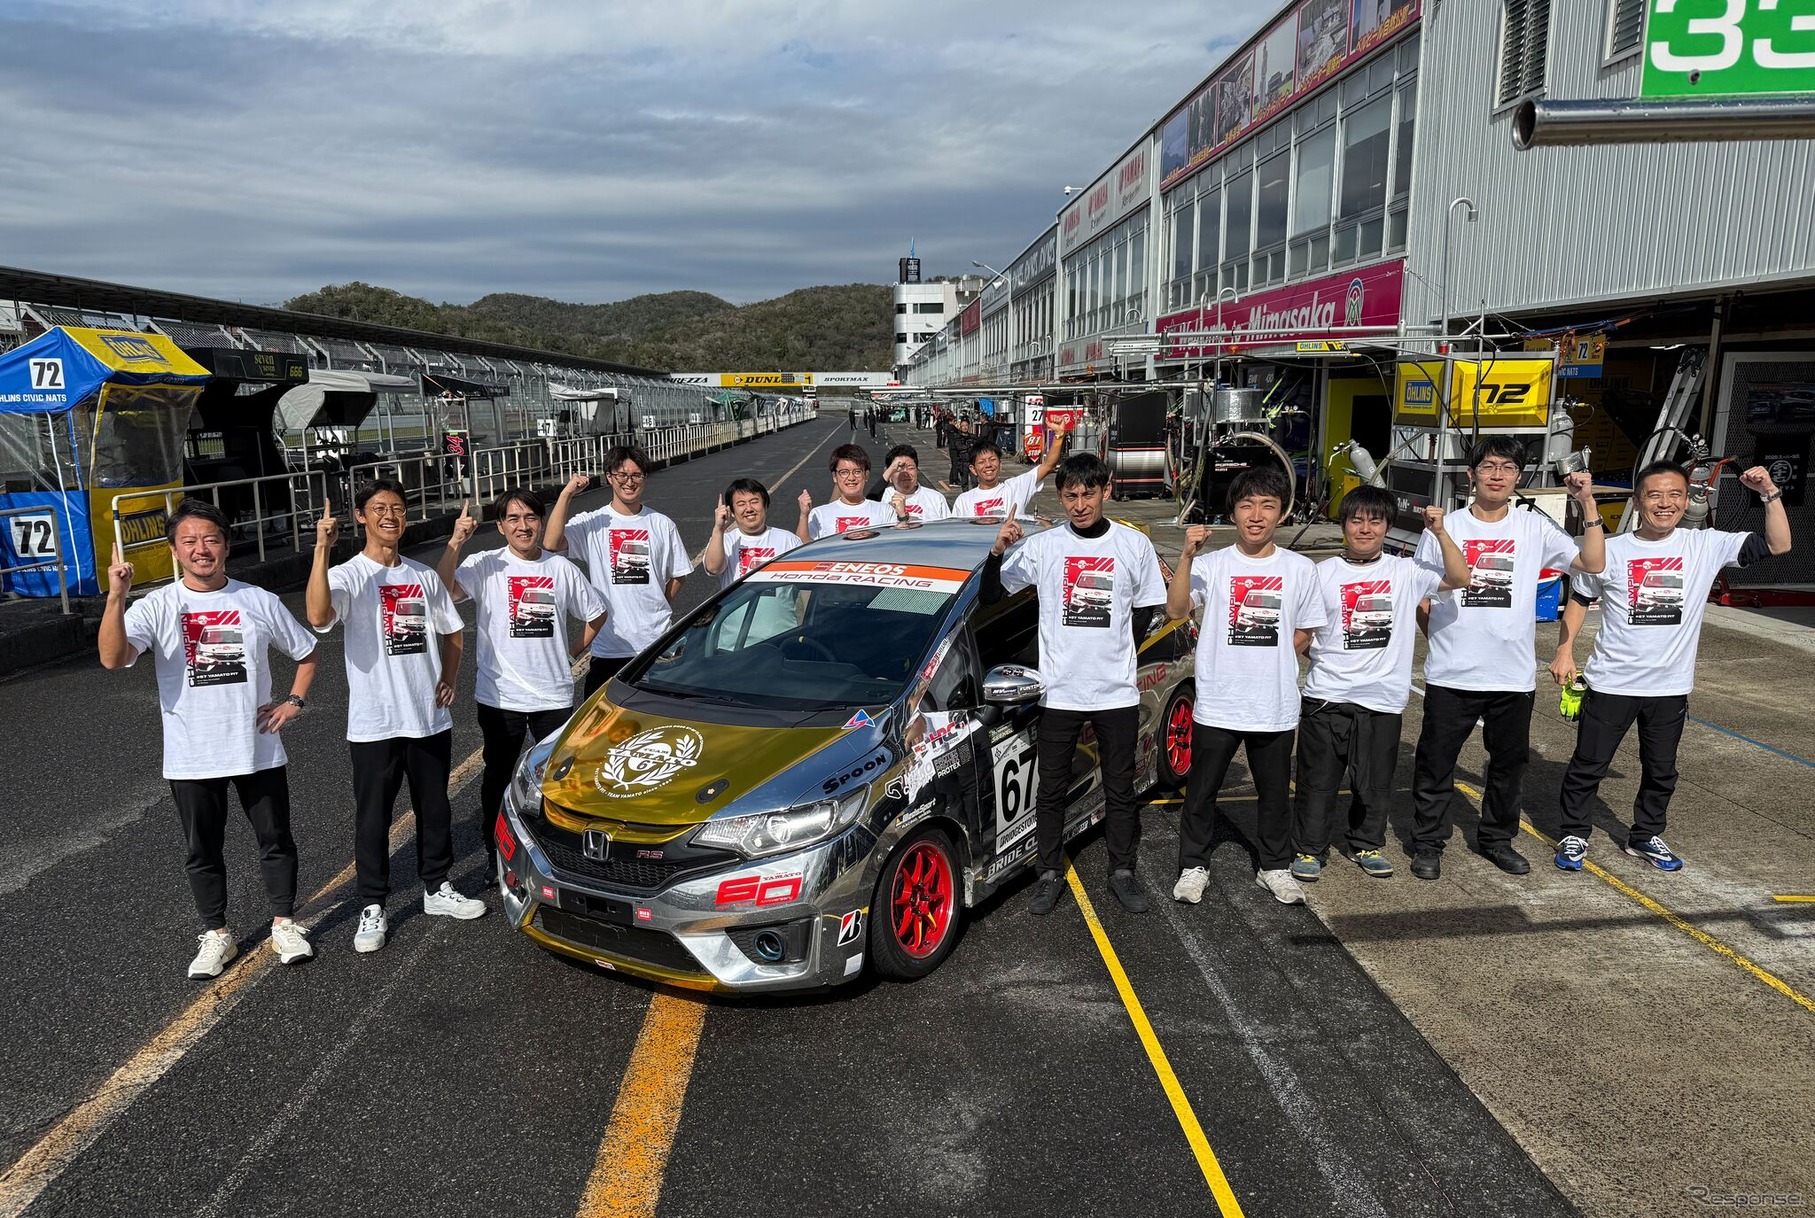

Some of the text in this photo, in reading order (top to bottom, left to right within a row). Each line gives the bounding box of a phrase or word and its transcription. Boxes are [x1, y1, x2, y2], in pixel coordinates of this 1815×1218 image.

[1578, 342, 1589, 360] 72
[32, 361, 62, 387] 72
[22, 393, 44, 402] CIVIC
[45, 393, 67, 402] NATS
[1473, 383, 1531, 404] 72
[15, 520, 55, 555] 72
[770, 572, 934, 588] Honda RACING
[829, 562, 909, 576] ENEOS
[1228, 576, 1236, 645] CHAMPION
[180, 613, 196, 687] CHAMPION
[822, 754, 887, 795] SPOON
[937, 760, 961, 779] PROTEX
[1001, 744, 1038, 823] 67
[636, 849, 664, 859] RS
[986, 844, 1023, 877] BRIDE
[762, 871, 802, 881] YAMATO
[715, 875, 802, 907] 60
